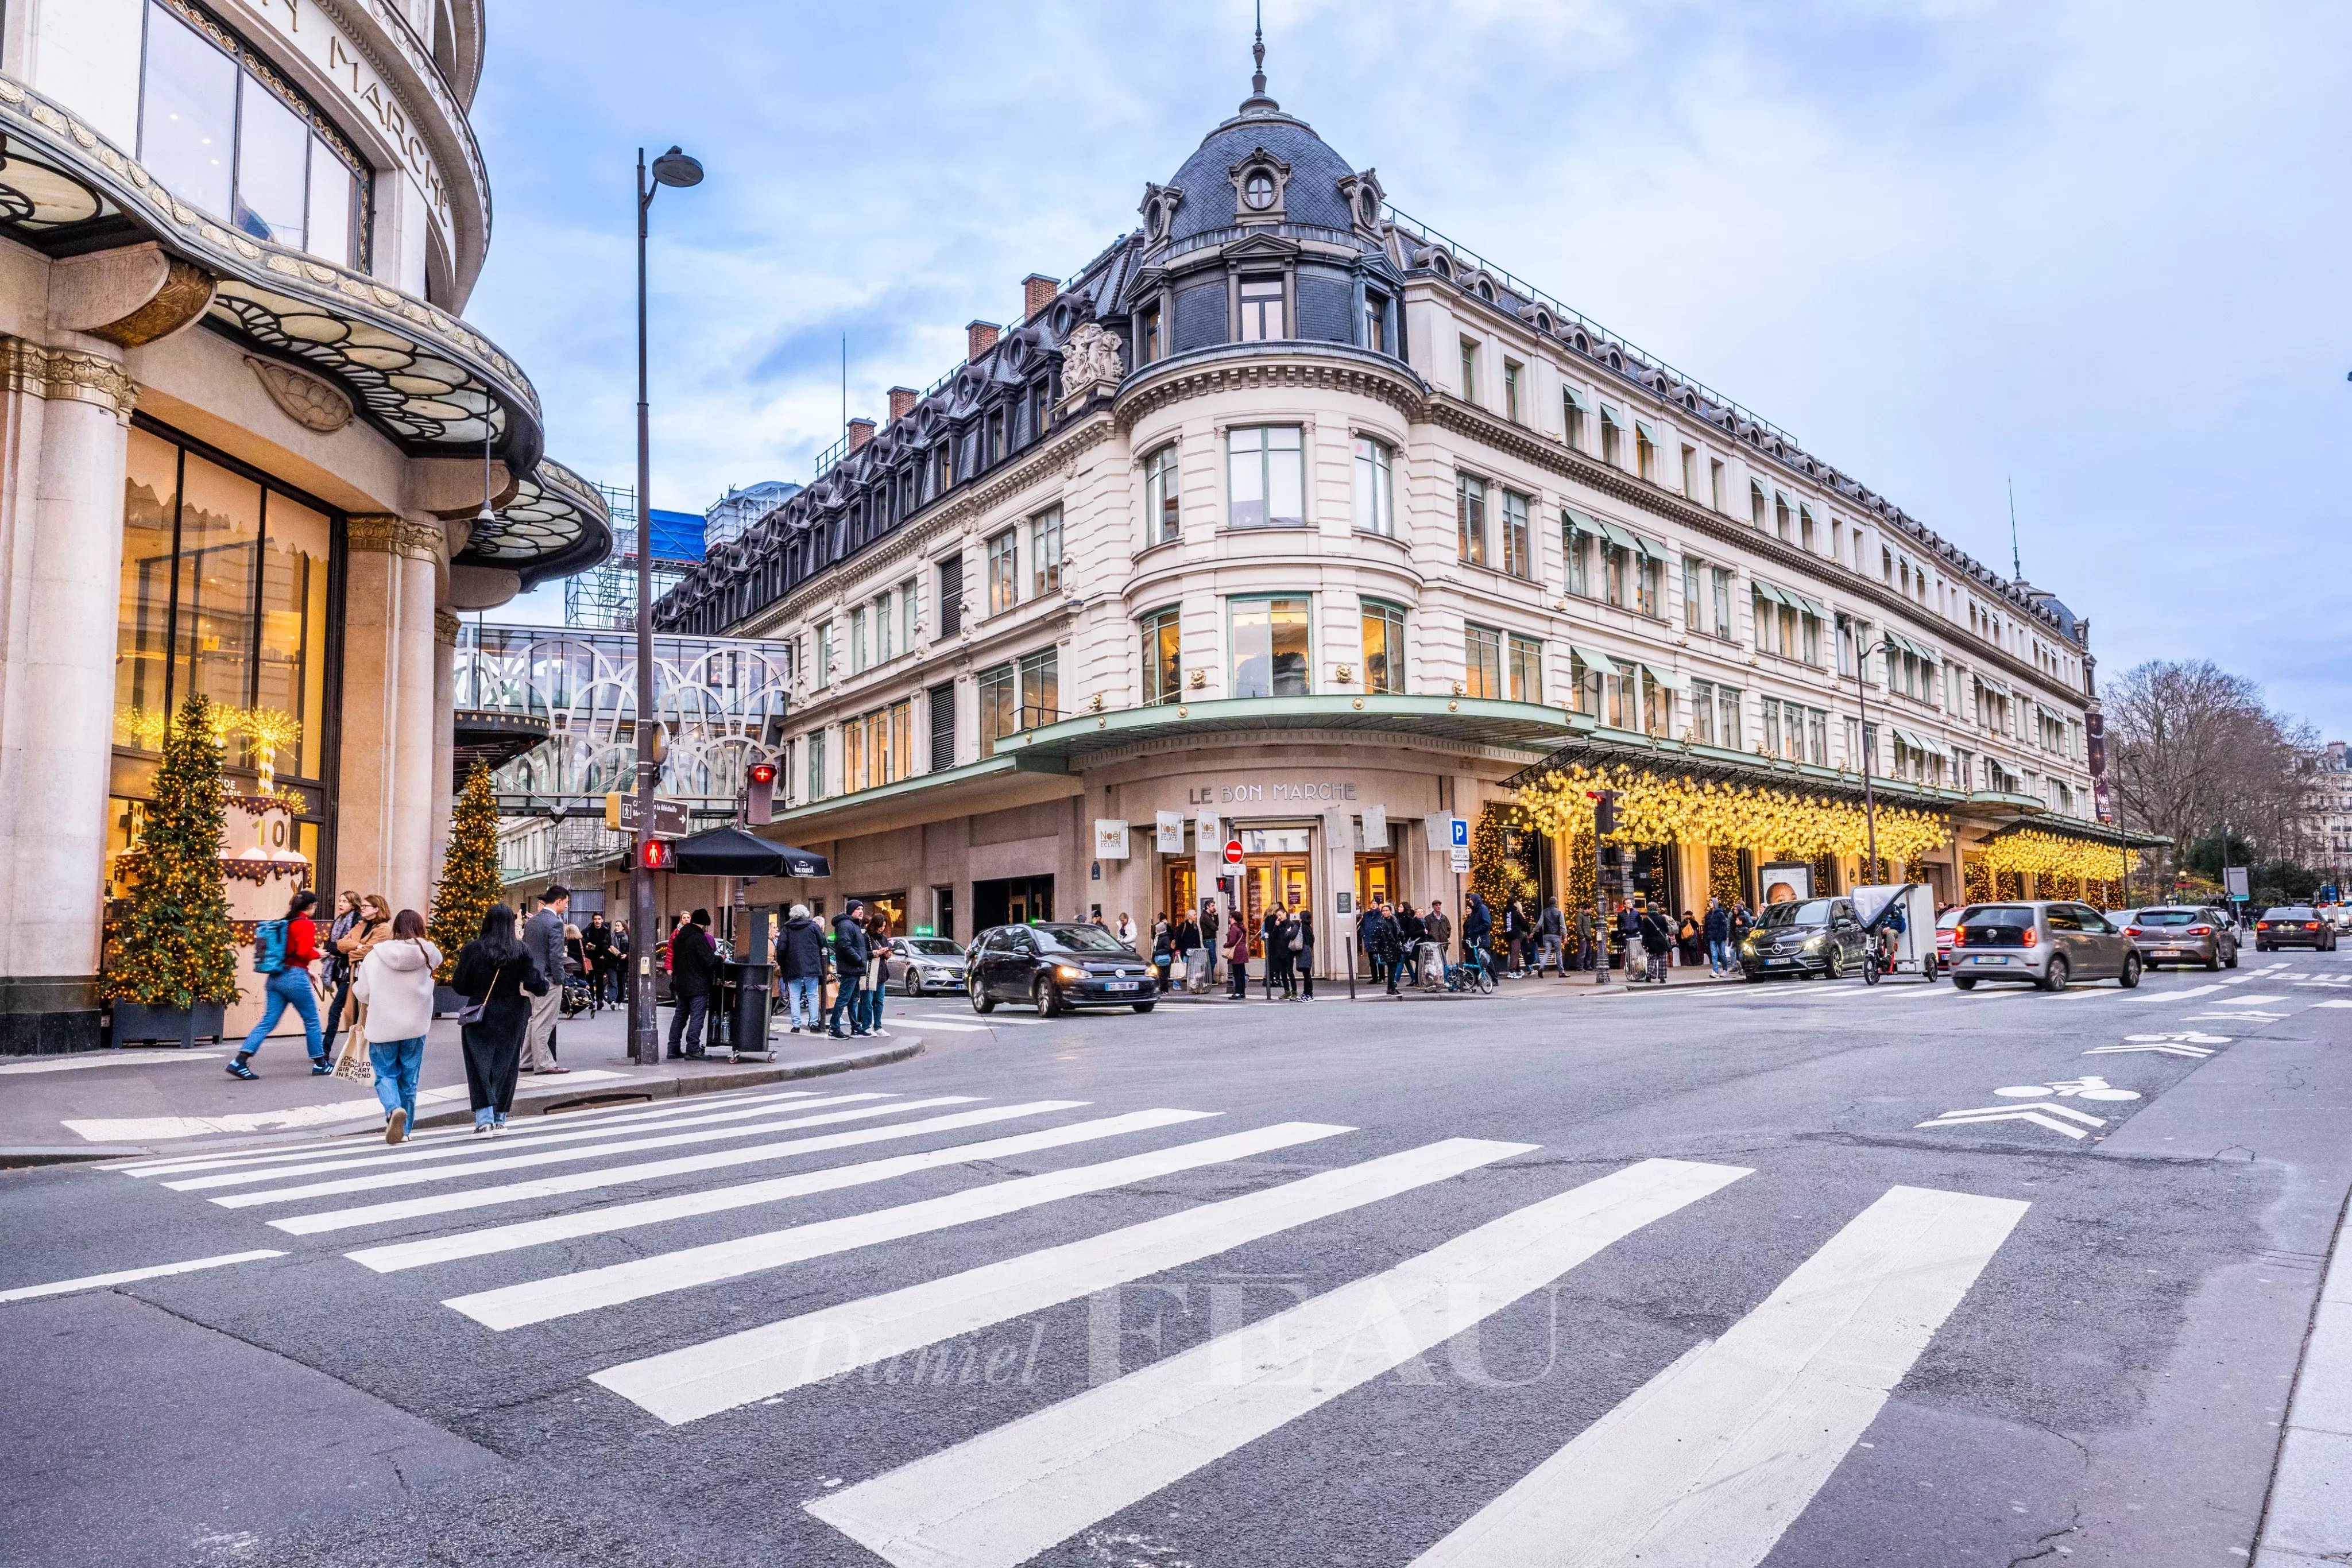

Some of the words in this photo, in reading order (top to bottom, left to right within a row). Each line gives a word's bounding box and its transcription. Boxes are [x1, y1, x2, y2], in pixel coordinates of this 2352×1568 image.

[1189, 787, 1213, 804] LE
[1221, 784, 1262, 803] BON
[661, 804, 678, 812] Médaille
[1160, 823, 1177, 833] Noël
[1456, 824, 1464, 841] P
[1100, 831, 1121, 841] Noël
